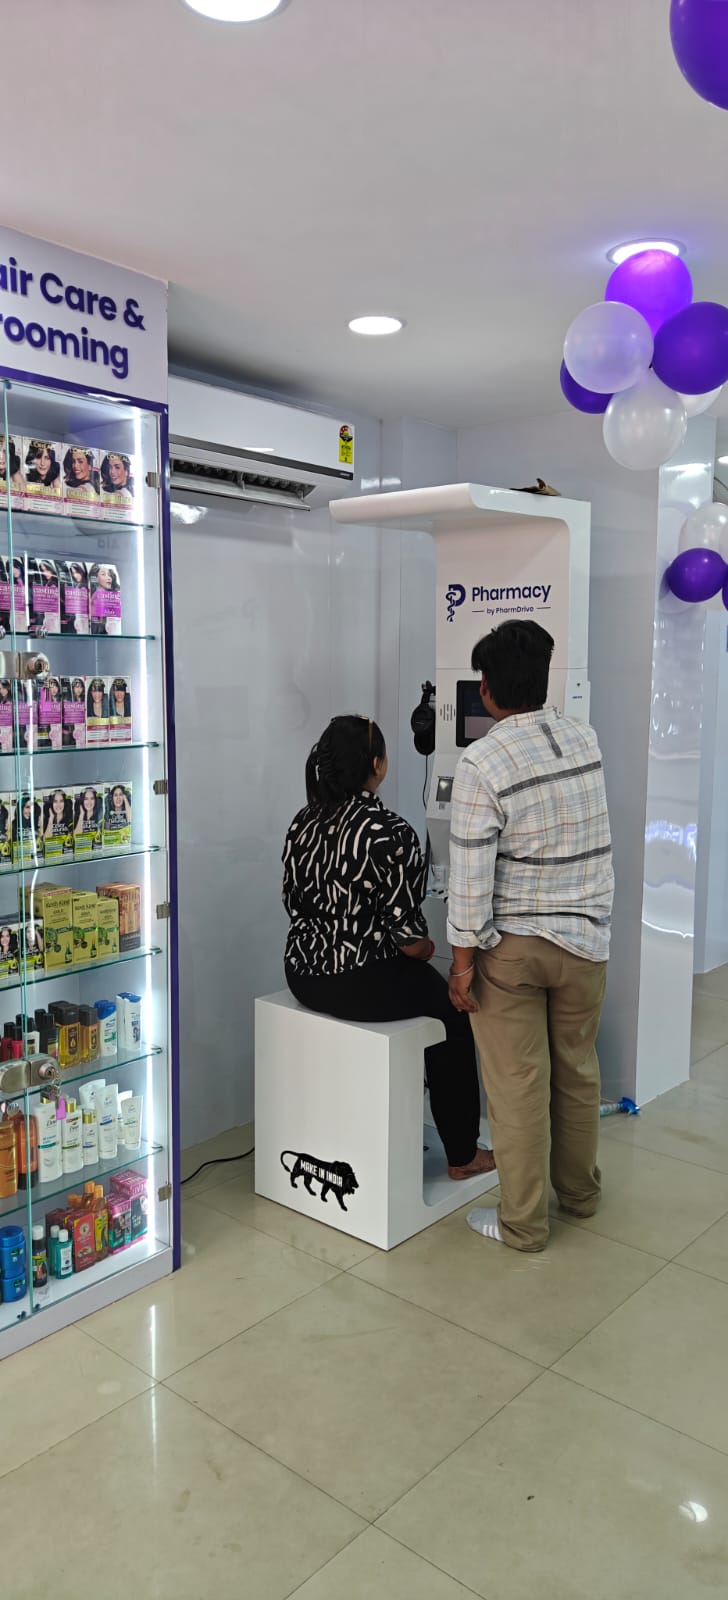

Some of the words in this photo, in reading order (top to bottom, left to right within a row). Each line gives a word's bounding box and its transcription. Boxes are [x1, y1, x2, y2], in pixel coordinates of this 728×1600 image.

[40, 272, 117, 321] Care
[123, 298, 145, 331] &
[33, 587, 58, 596] casting
[472, 585, 551, 602] Pharmacy
[496, 605, 534, 614] PharmDrive
[300, 1160, 318, 1176] MAKE
[318, 1168, 325, 1180] IN
[326, 1170, 343, 1188] INDIA
